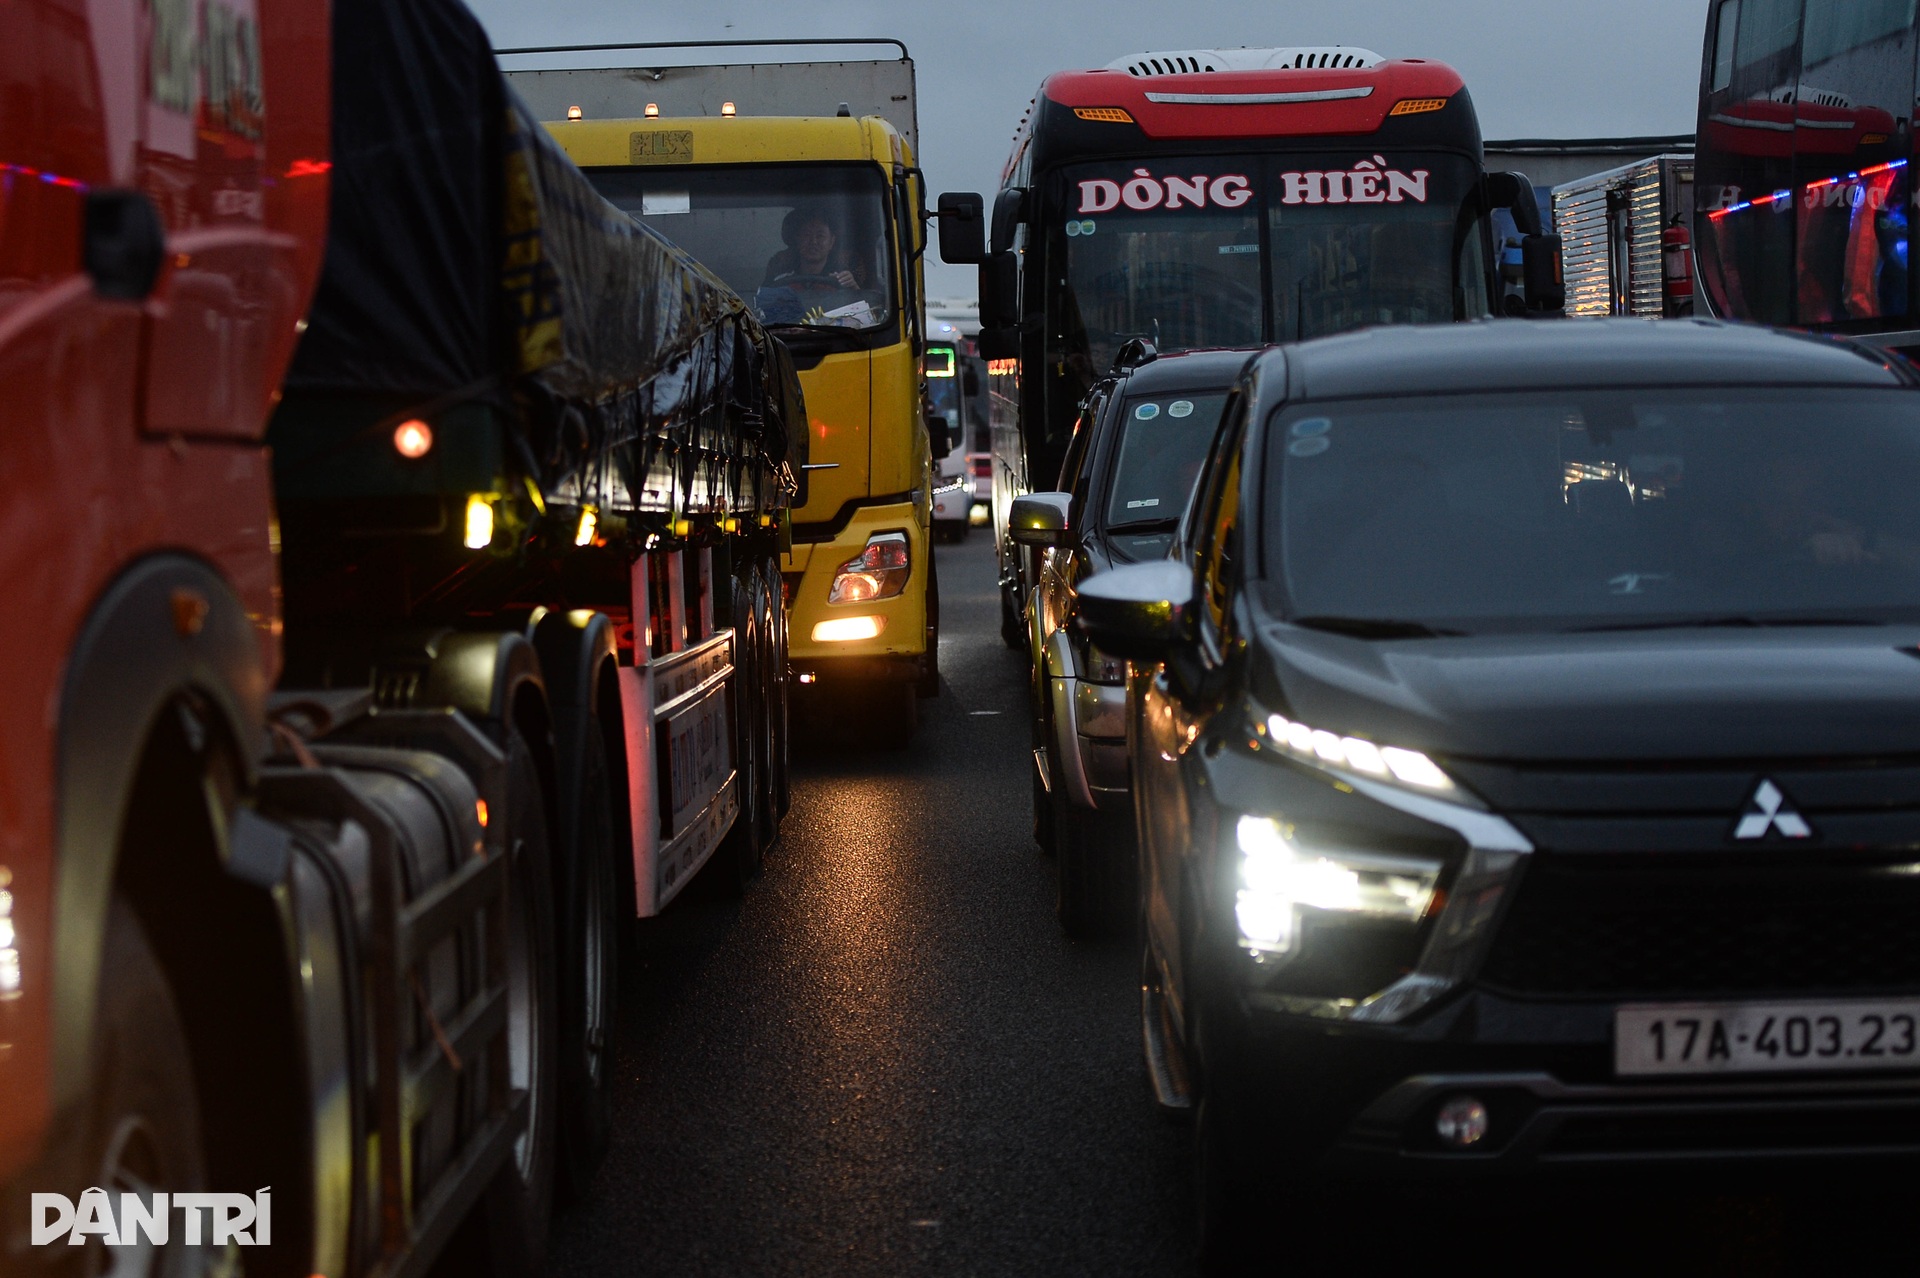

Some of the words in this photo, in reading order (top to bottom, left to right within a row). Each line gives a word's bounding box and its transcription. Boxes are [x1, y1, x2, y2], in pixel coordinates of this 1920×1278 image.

[1077, 167, 1254, 214] DÒNG
[1280, 153, 1430, 205] HIỀN
[1649, 1014, 1916, 1062] 17A-403.23
